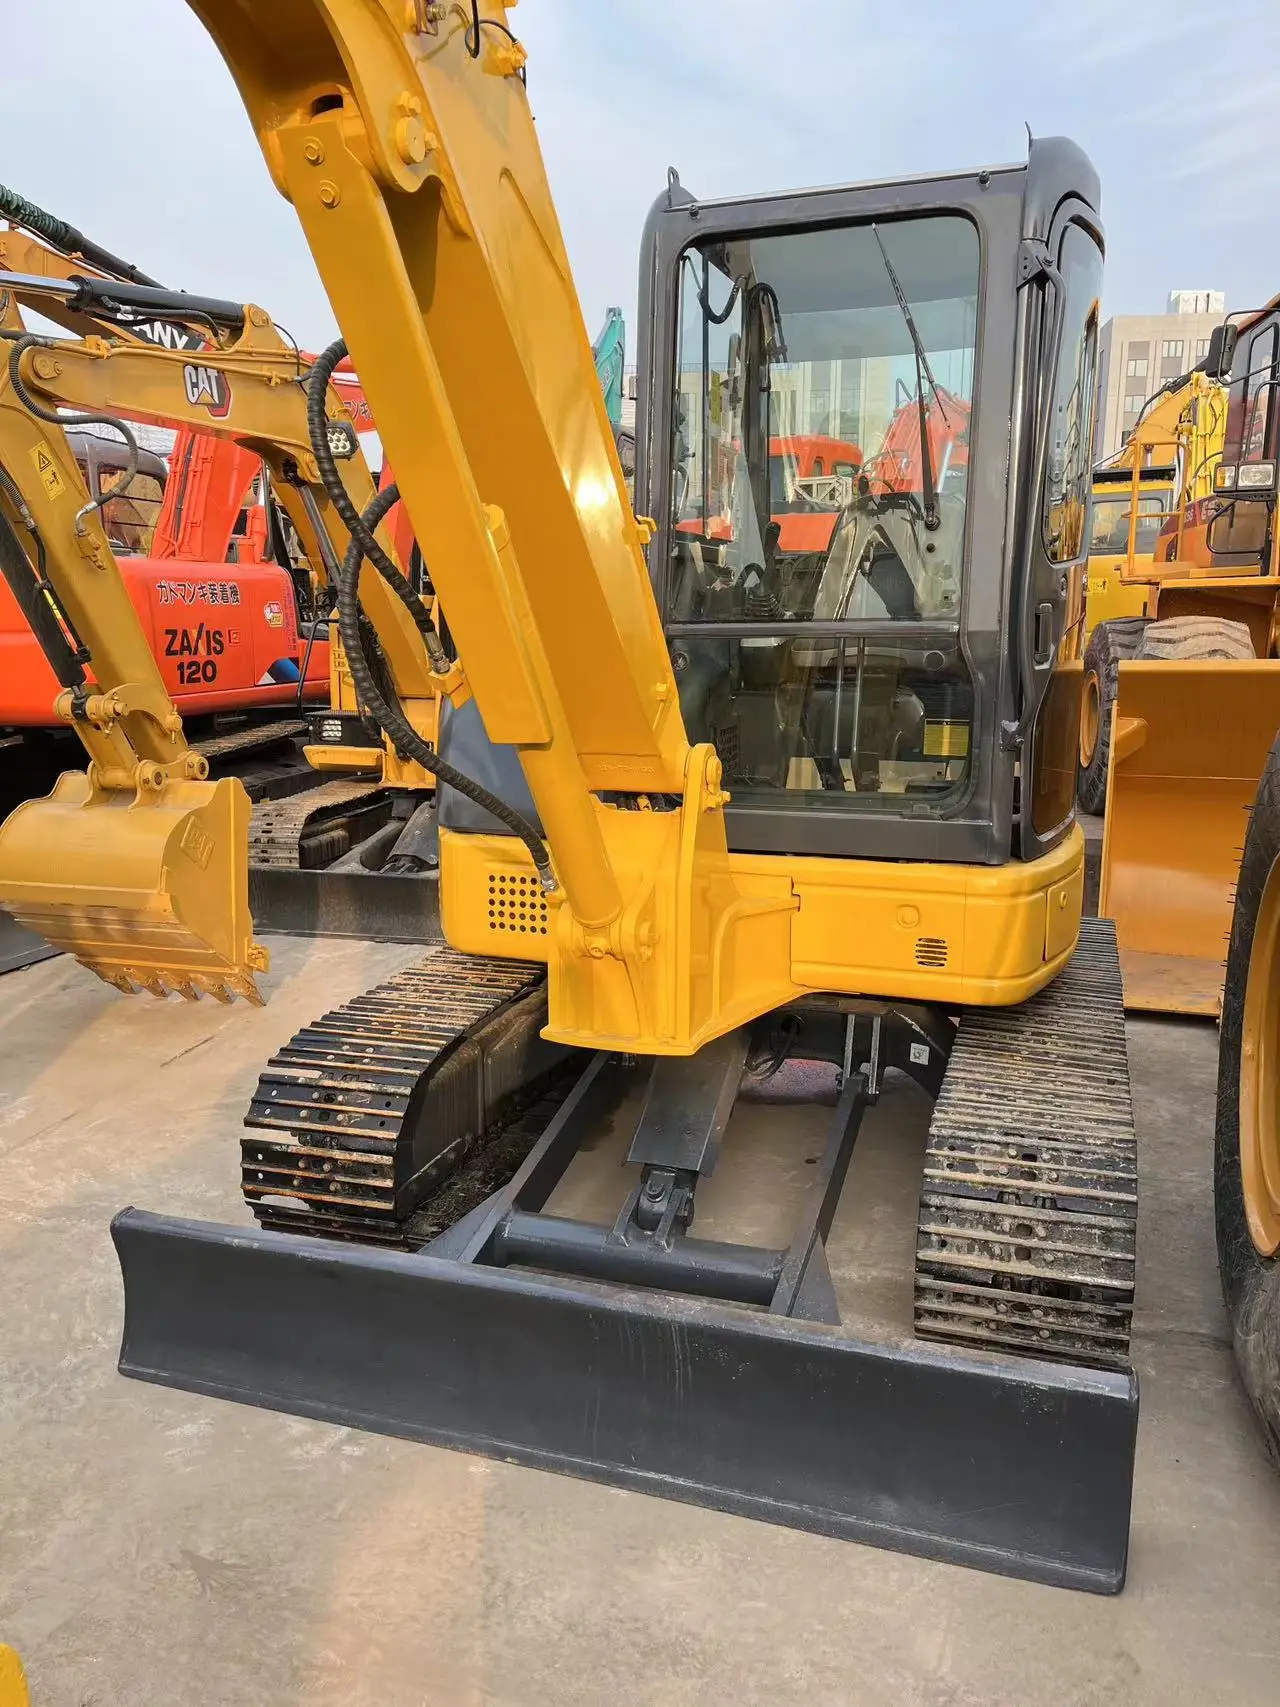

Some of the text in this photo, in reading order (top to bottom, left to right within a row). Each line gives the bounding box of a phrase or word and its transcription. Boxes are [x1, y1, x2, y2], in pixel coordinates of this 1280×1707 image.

[184, 364, 220, 404] CAT
[164, 622, 225, 656] ZAXIS
[177, 659, 217, 685] 120
